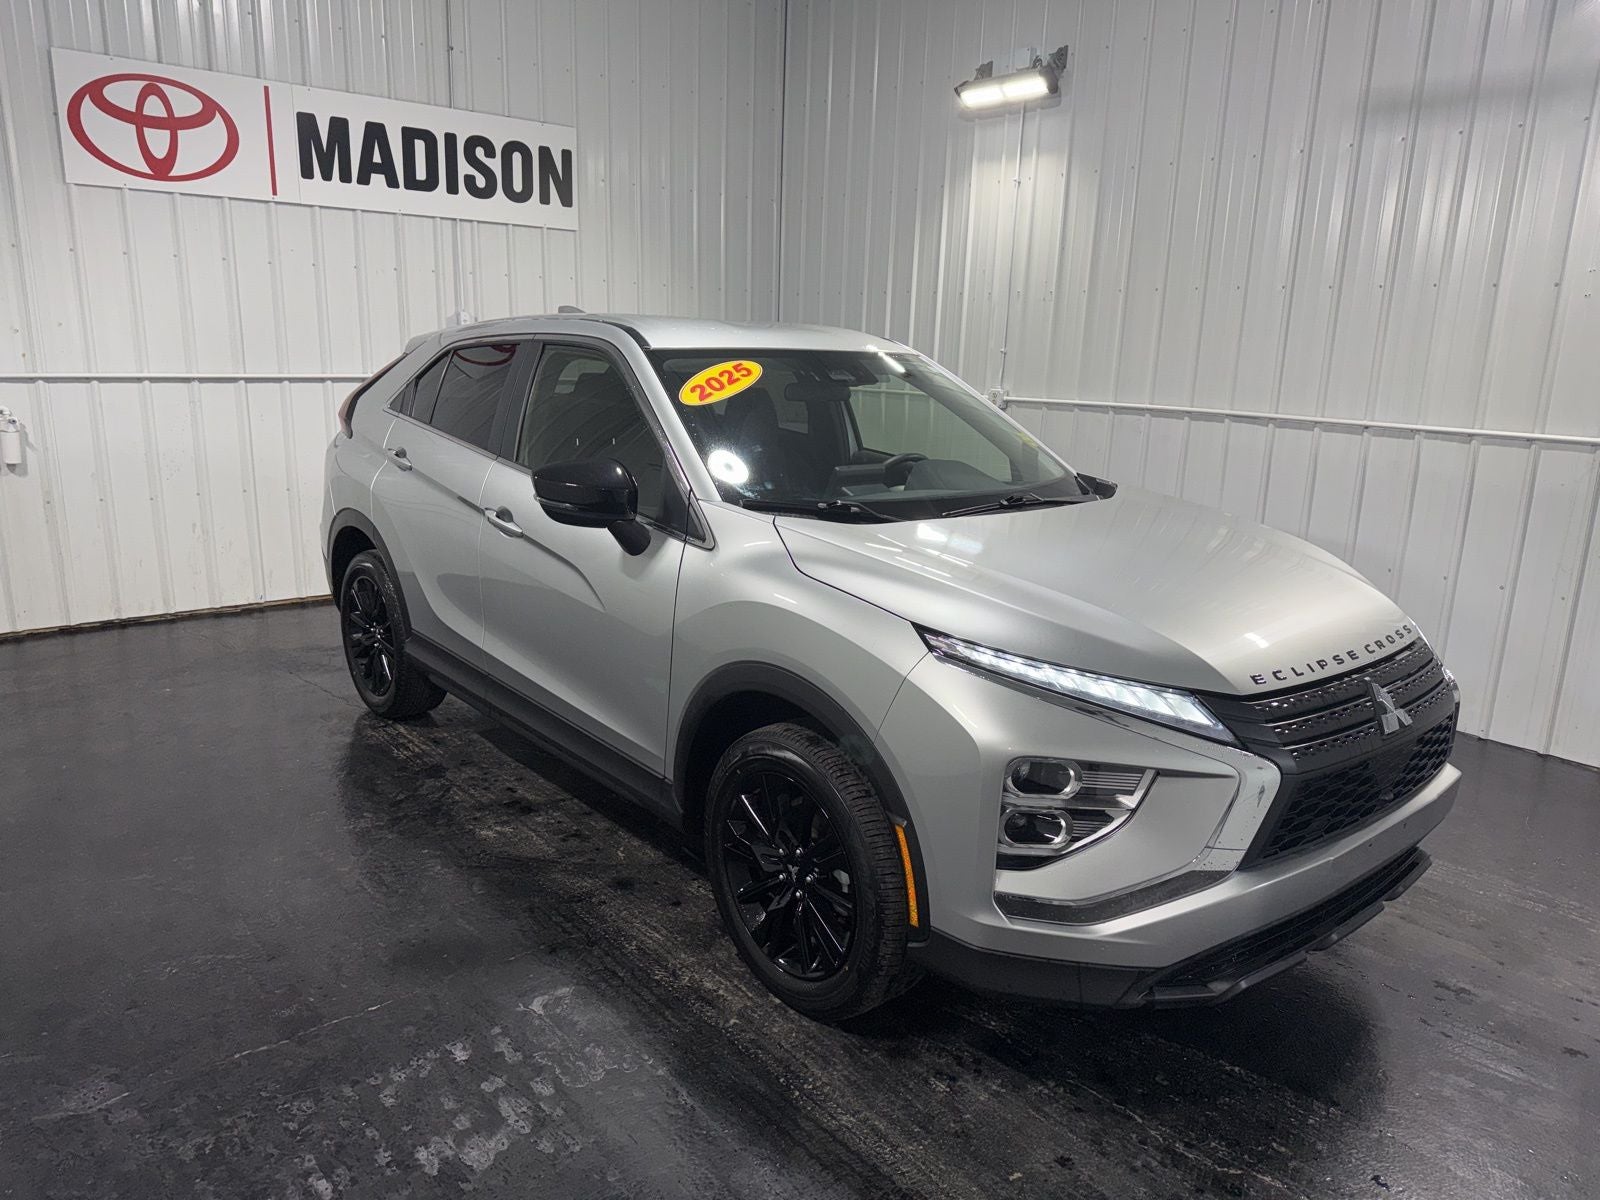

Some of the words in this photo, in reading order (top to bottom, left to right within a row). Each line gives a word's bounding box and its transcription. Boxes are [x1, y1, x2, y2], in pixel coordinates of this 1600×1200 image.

[296, 111, 573, 208] MADISON
[690, 362, 753, 402] 2025
[1249, 650, 1360, 686] ECLIPSE
[1364, 624, 1413, 655] CROSS
